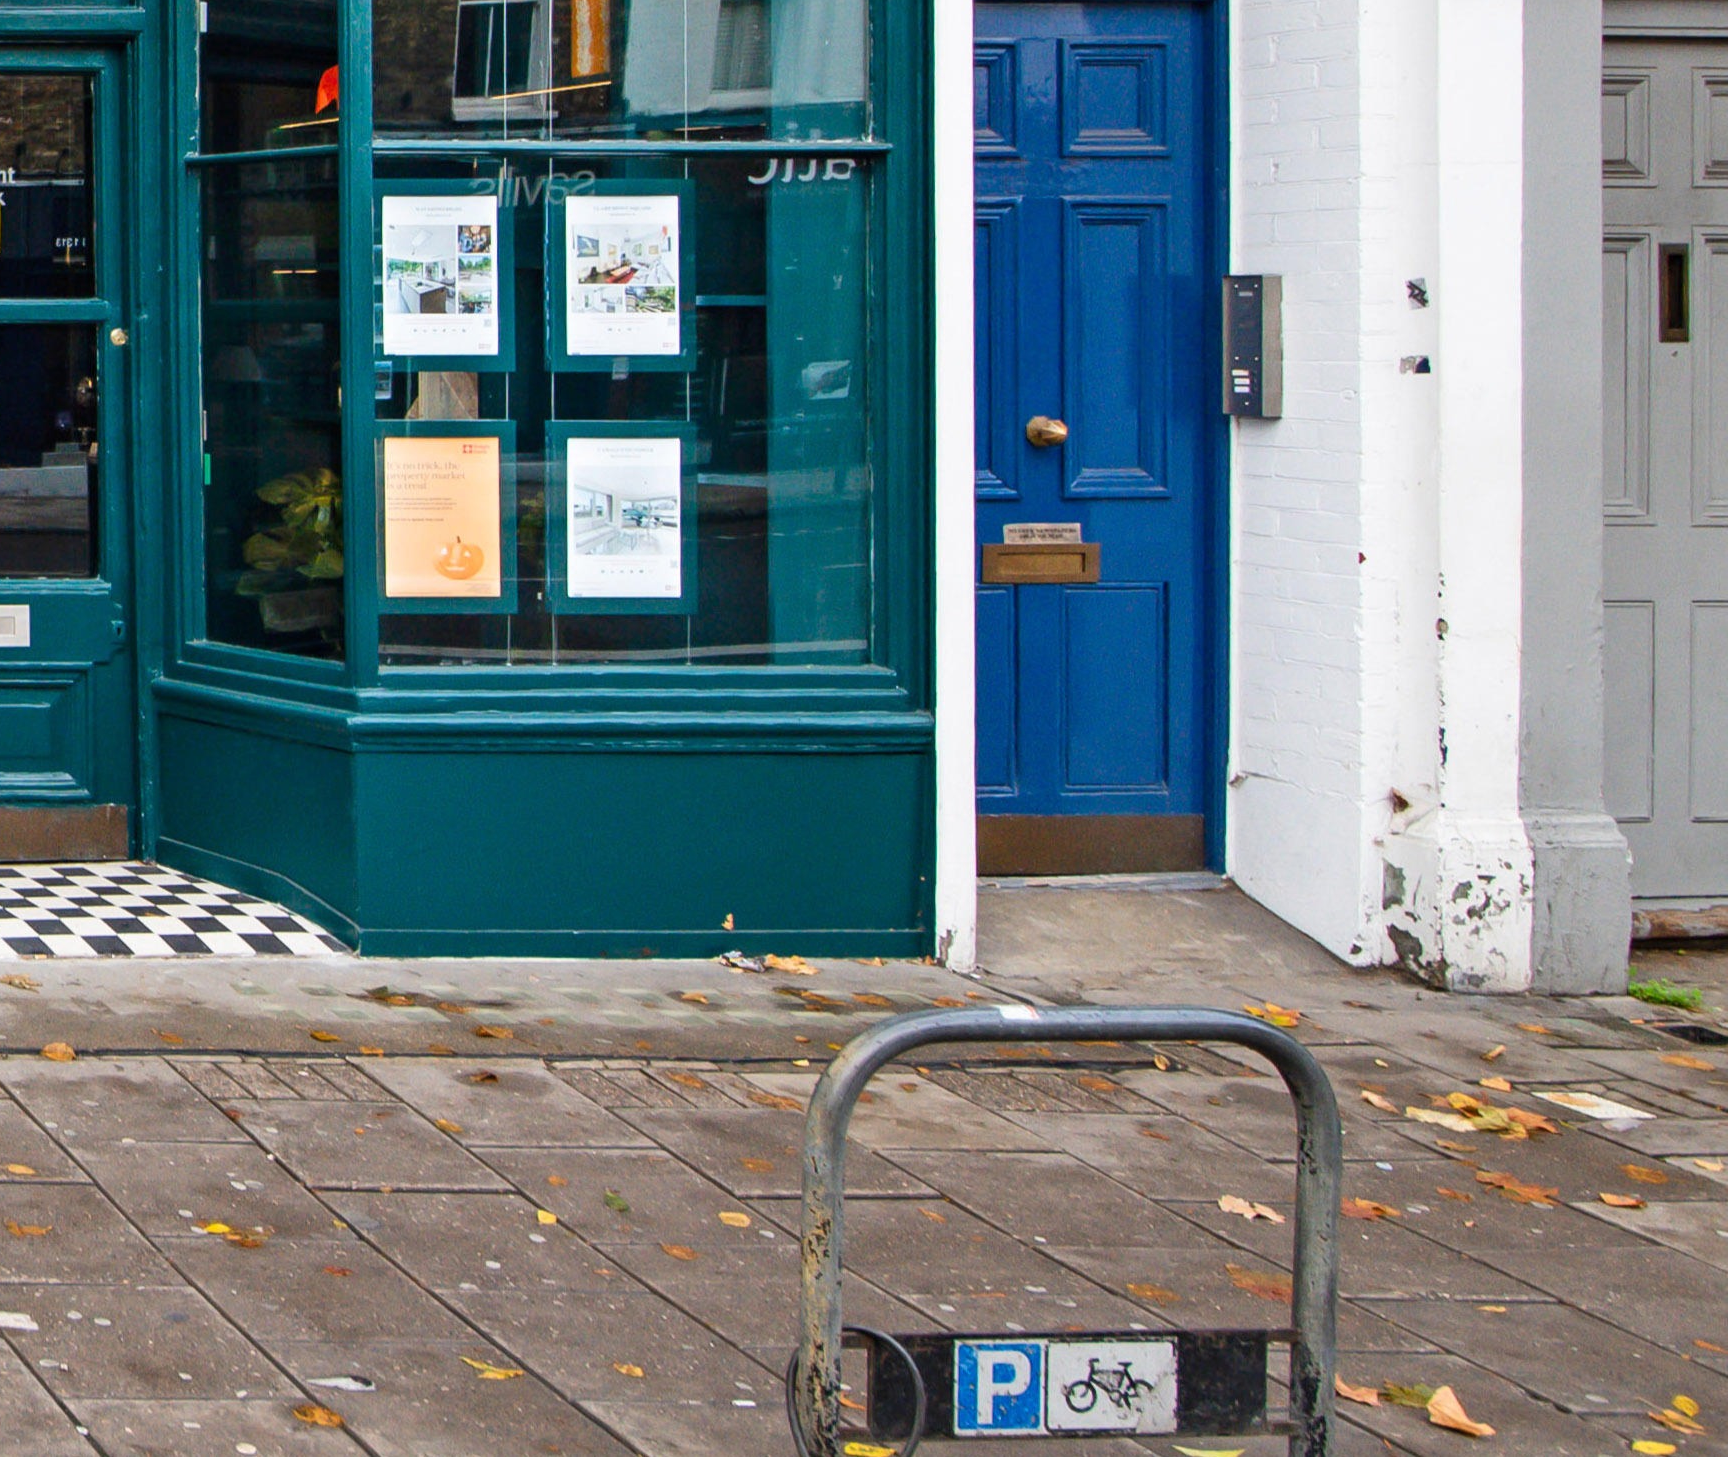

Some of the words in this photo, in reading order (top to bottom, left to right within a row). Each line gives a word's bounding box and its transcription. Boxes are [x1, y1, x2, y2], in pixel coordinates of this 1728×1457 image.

[444, 461, 460, 470] the
[431, 471, 466, 480] market
[976, 1348, 1032, 1425] P
